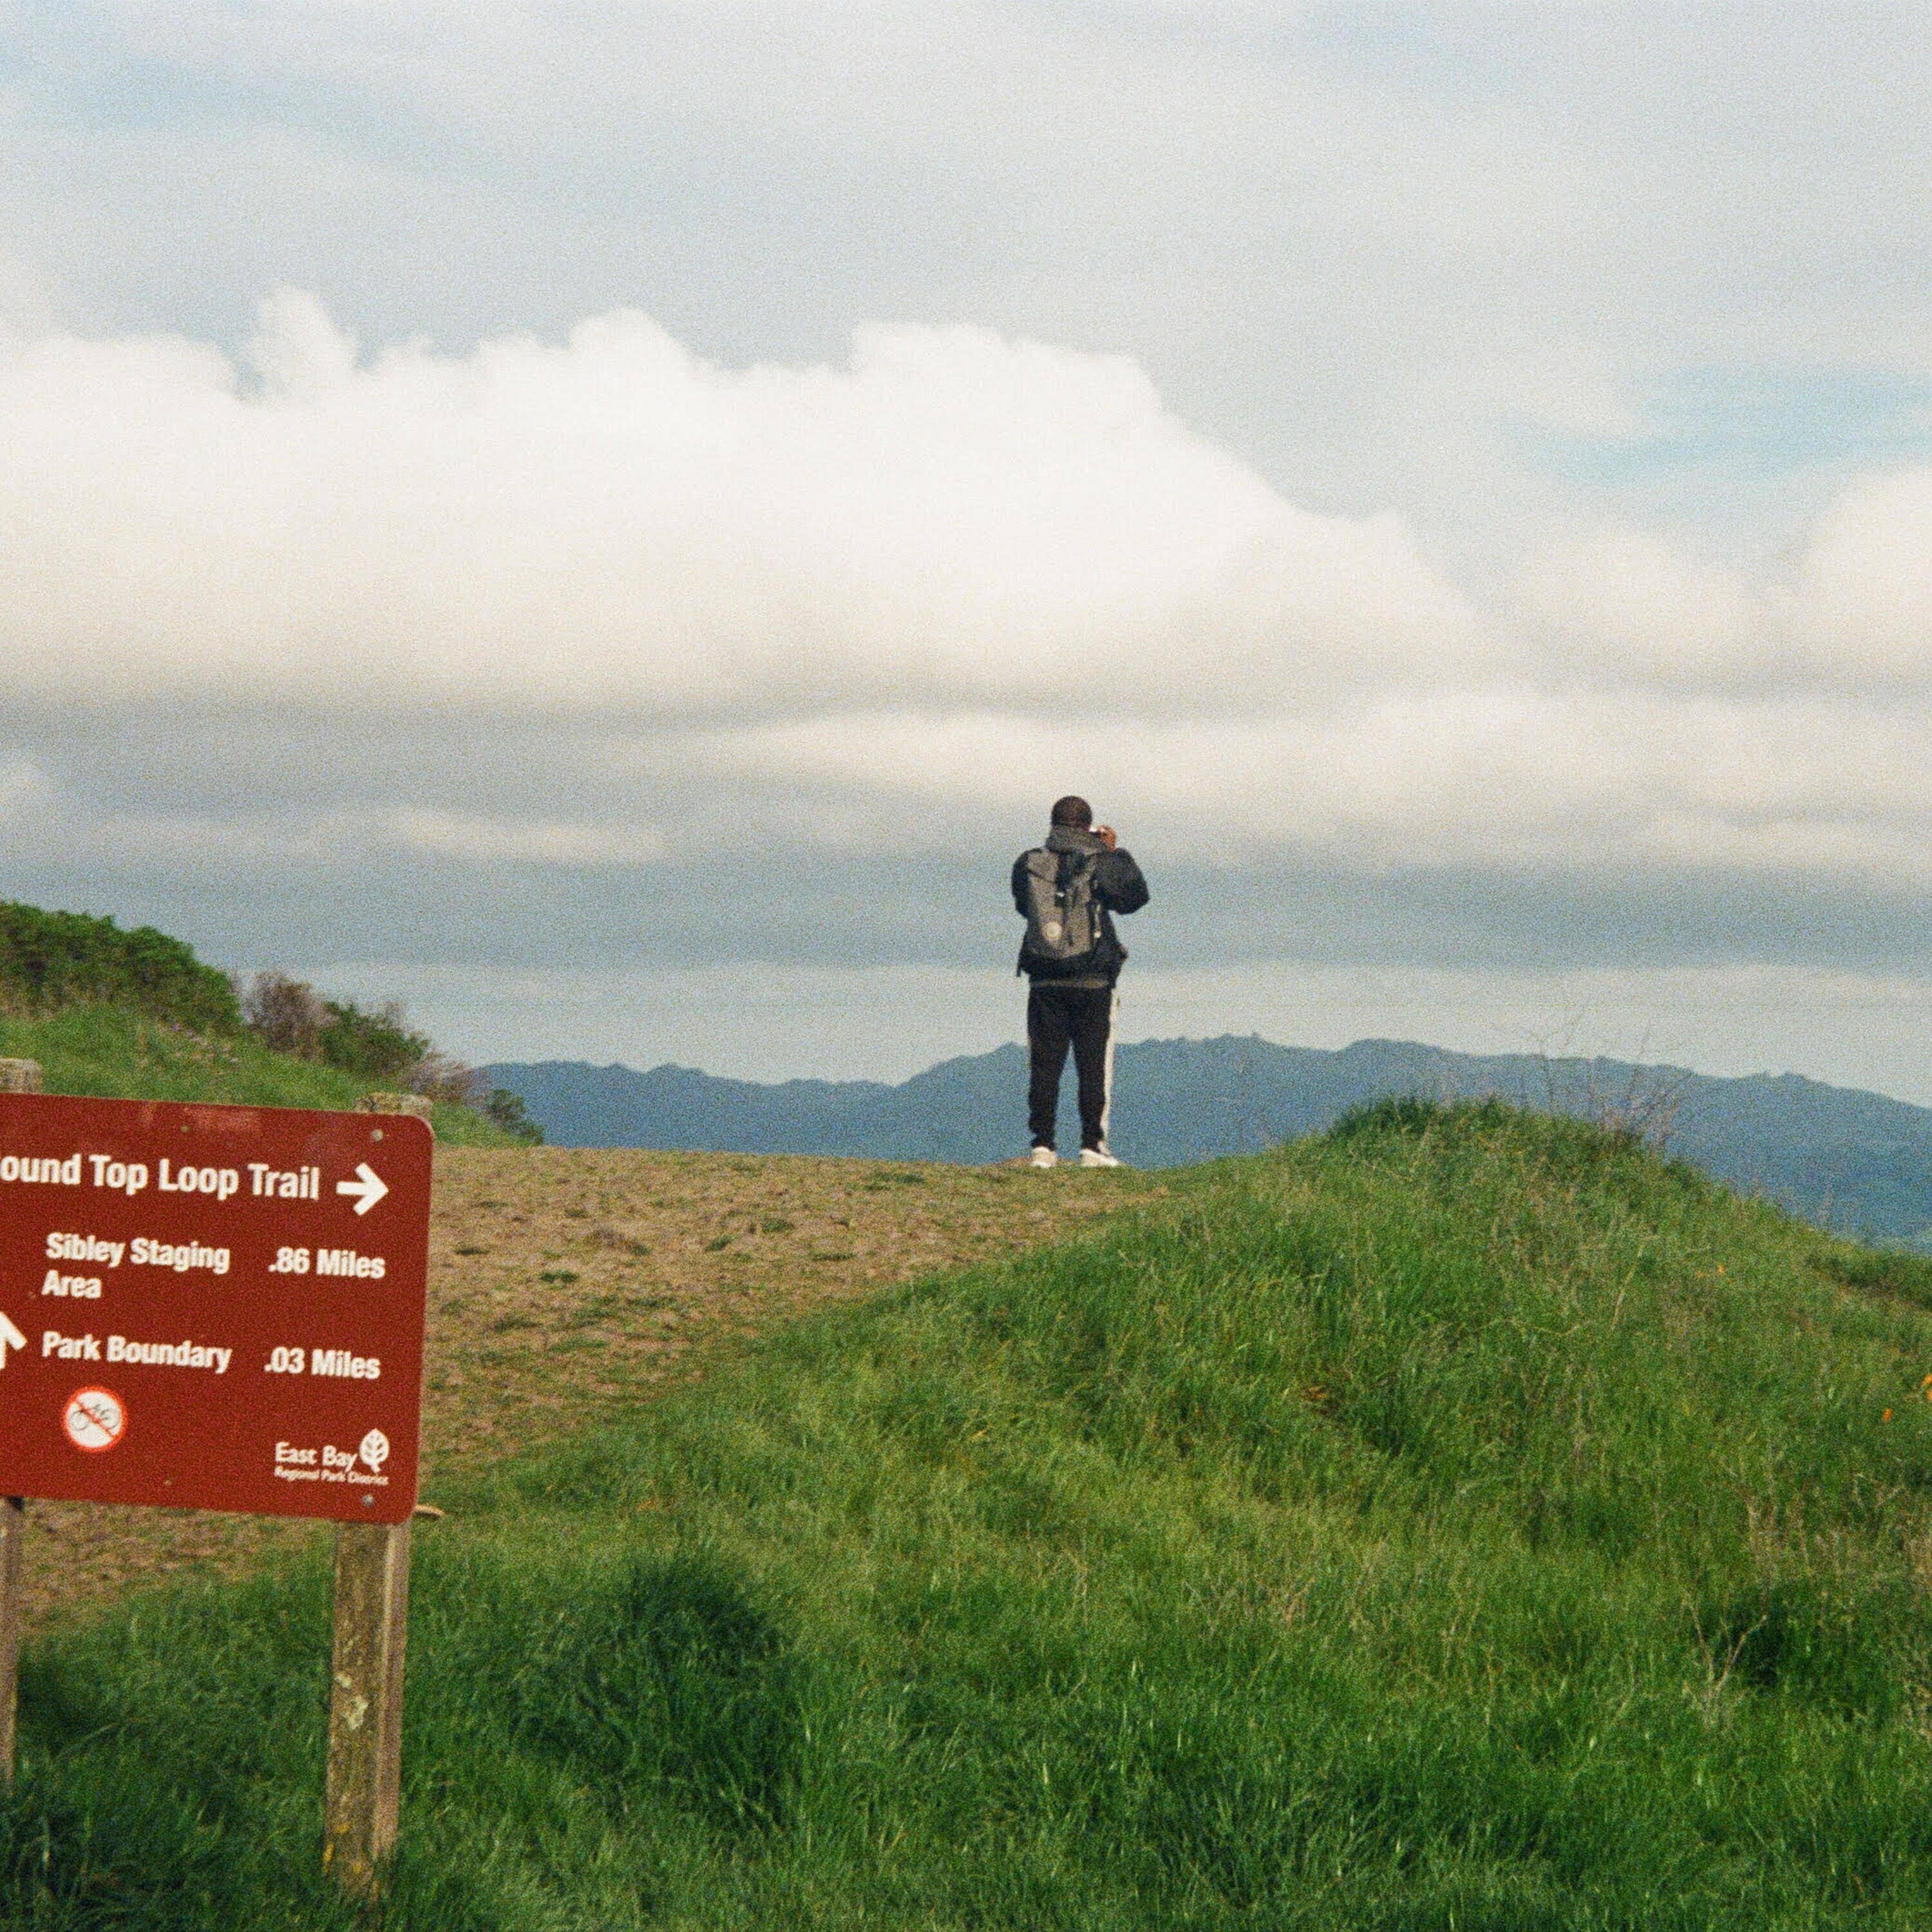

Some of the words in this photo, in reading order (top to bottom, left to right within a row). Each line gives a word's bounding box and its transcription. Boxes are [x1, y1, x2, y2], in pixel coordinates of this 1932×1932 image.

[89, 1154, 148, 1195] Top
[159, 1159, 239, 1200] Loop
[248, 1163, 319, 1200] Trail
[46, 1232, 125, 1267] Sibley
[130, 1238, 230, 1274] Staging
[269, 1247, 310, 1274] .86
[316, 1249, 385, 1279] Miles
[42, 1270, 101, 1298] Area
[43, 1331, 100, 1360] Park
[107, 1336, 232, 1374] Boundary
[265, 1347, 305, 1374] .03
[312, 1349, 381, 1379] Miles
[275, 1441, 317, 1464] East
[322, 1445, 357, 1473] Bay
